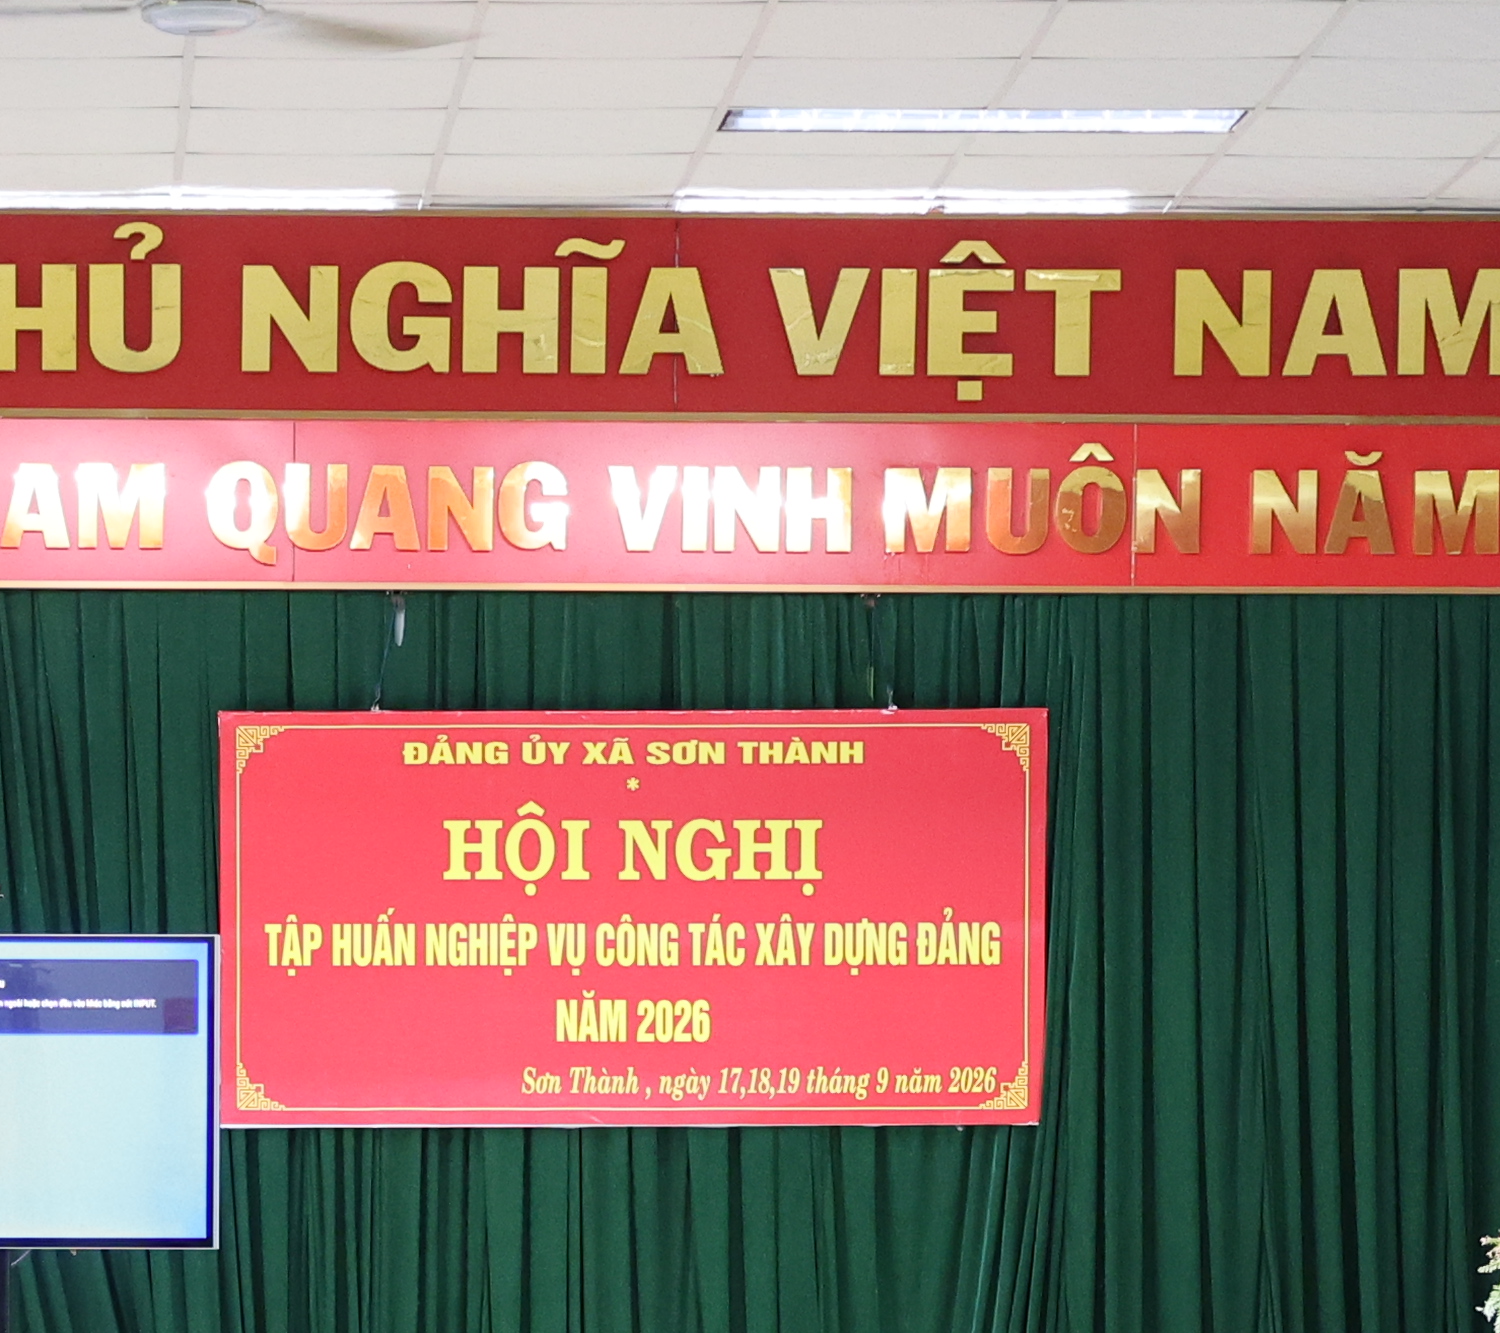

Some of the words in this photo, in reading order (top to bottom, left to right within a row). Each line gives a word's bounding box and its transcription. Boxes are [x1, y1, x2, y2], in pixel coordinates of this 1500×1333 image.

[241, 237, 725, 378] NGHĨA
[768, 239, 1122, 401] VIỆT
[204, 459, 571, 566] QUANG
[606, 463, 853, 554] VINH
[882, 442, 1202, 554] MUÔN
[402, 734, 509, 765] ĐẢNG
[522, 734, 571, 765] ỦY
[582, 737, 635, 765] XÃ
[646, 739, 725, 765] SƠN
[737, 736, 864, 764] THÀNH
[442, 800, 590, 897] HỘI
[618, 818, 823, 897] NGHỊ
[264, 914, 323, 977] TẬP
[332, 907, 416, 967] HUẤN
[425, 913, 538, 977] NGHIỆP
[546, 922, 586, 976] VỤ
[595, 913, 679, 967] CÔNG
[687, 913, 746, 967] TÁC
[754, 913, 816, 966] XÂY
[824, 917, 908, 976] DỰNG
[916, 906, 1001, 966] ĐẢNG
[555, 989, 628, 1043] NĂM
[636, 998, 711, 1043] 2026
[521, 1066, 563, 1095] Sơn
[569, 1066, 640, 1095] Thành
[658, 1067, 711, 1101] ngày
[717, 1067, 801, 1100] 17,18,19
[806, 1066, 871, 1101] tháng
[875, 1066, 889, 1094] 9
[894, 1067, 943, 1094] năm
[947, 1066, 998, 1096] 2026
